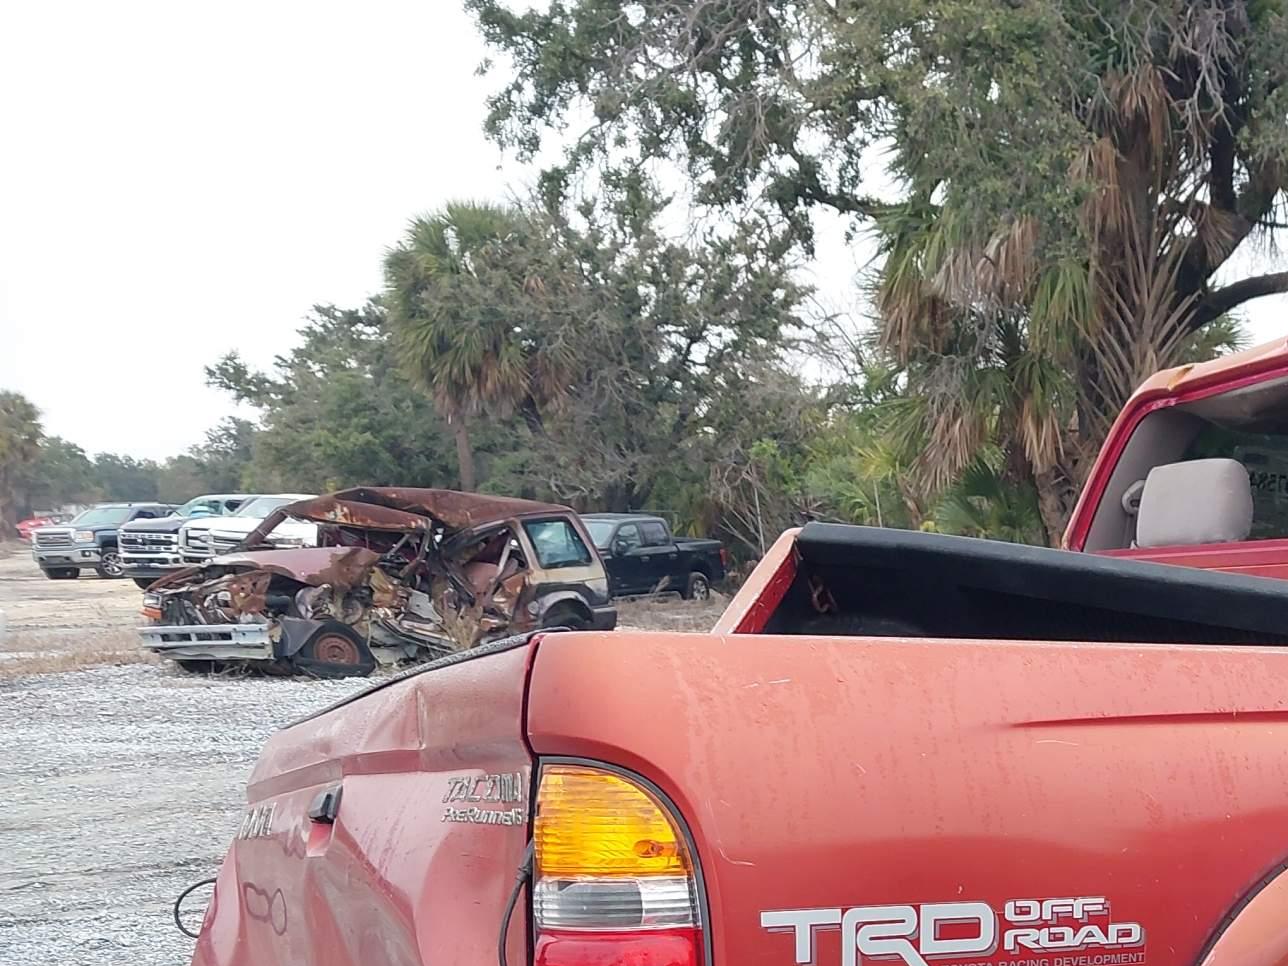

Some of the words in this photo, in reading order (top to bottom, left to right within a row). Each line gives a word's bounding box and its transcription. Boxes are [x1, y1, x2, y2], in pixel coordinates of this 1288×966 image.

[442, 772, 522, 804] TACOMA
[1004, 897, 1110, 925] OFF
[1004, 923, 1145, 953] ROAD
